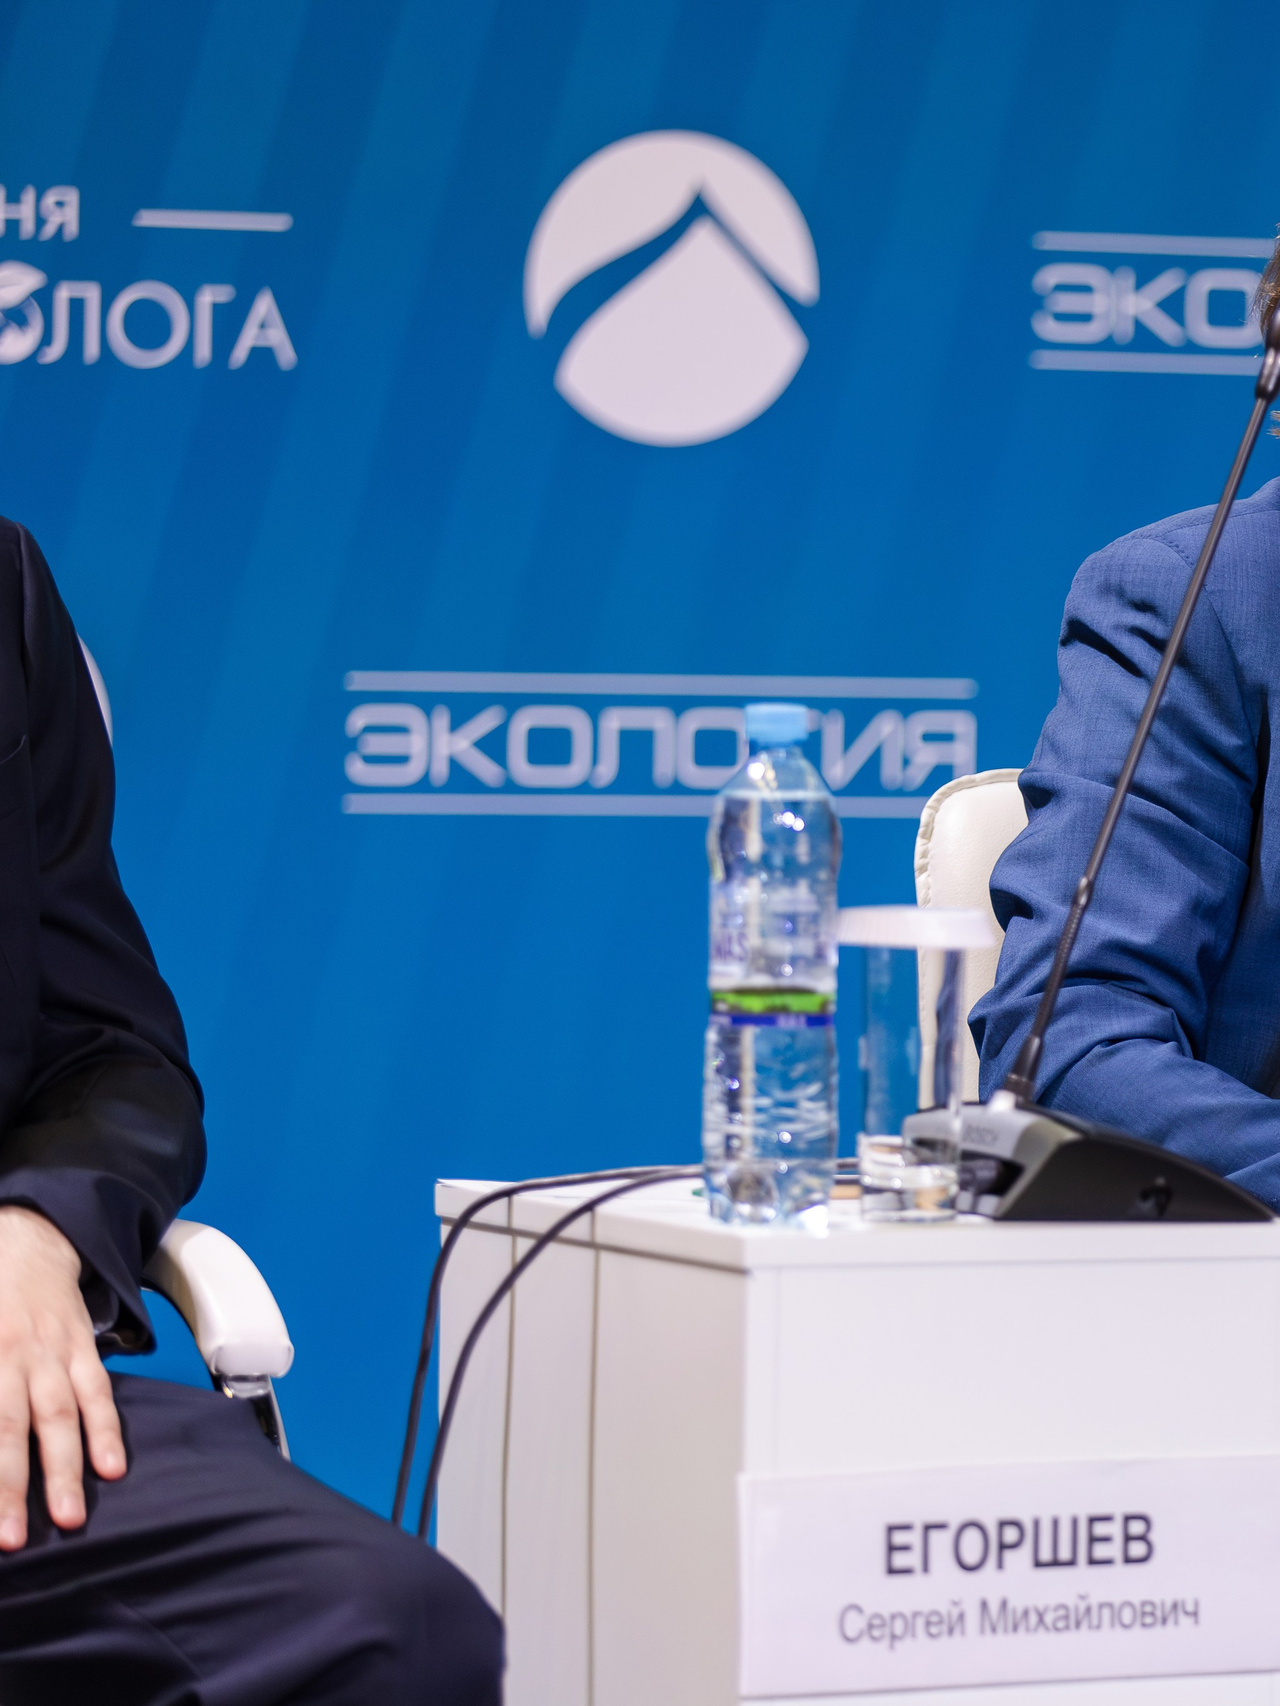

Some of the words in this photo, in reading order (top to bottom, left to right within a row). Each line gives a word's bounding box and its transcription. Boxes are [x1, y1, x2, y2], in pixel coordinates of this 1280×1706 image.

[345, 702, 977, 793] ЭКОЛОИЯ
[883, 1511, 1156, 1577] ЕГОРШЕВ
[838, 1596, 967, 1651] Сергей
[977, 1592, 1202, 1638] Михайлович
